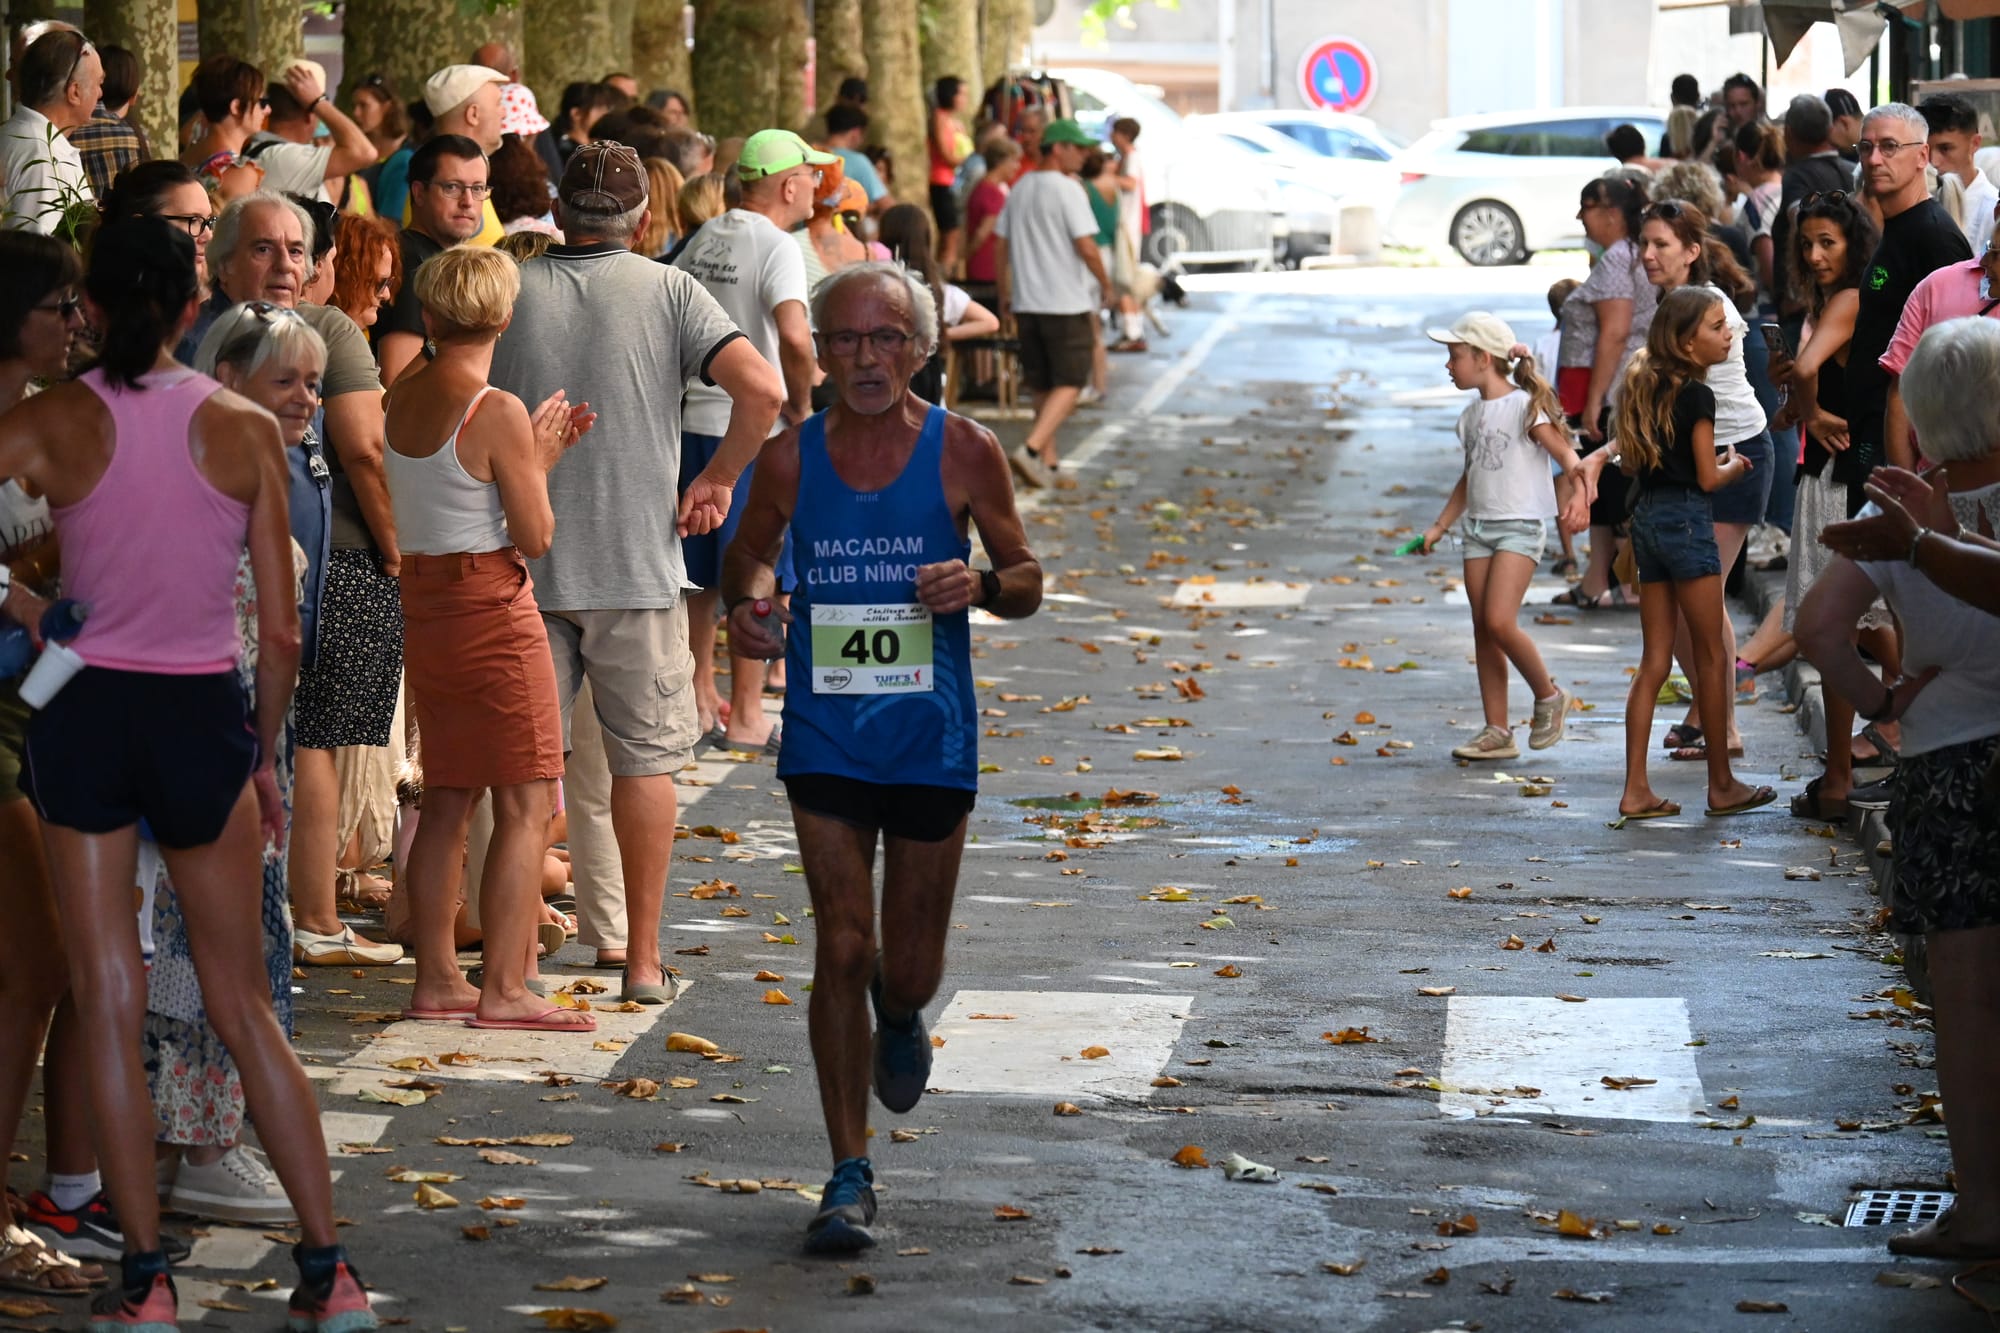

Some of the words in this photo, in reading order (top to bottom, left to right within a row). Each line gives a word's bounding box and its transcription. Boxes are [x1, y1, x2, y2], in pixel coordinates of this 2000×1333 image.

[814, 536, 923, 557] MACADAM
[807, 565, 858, 584] CLUB
[864, 561, 919, 583] NÎMO
[841, 629, 900, 665] 40
